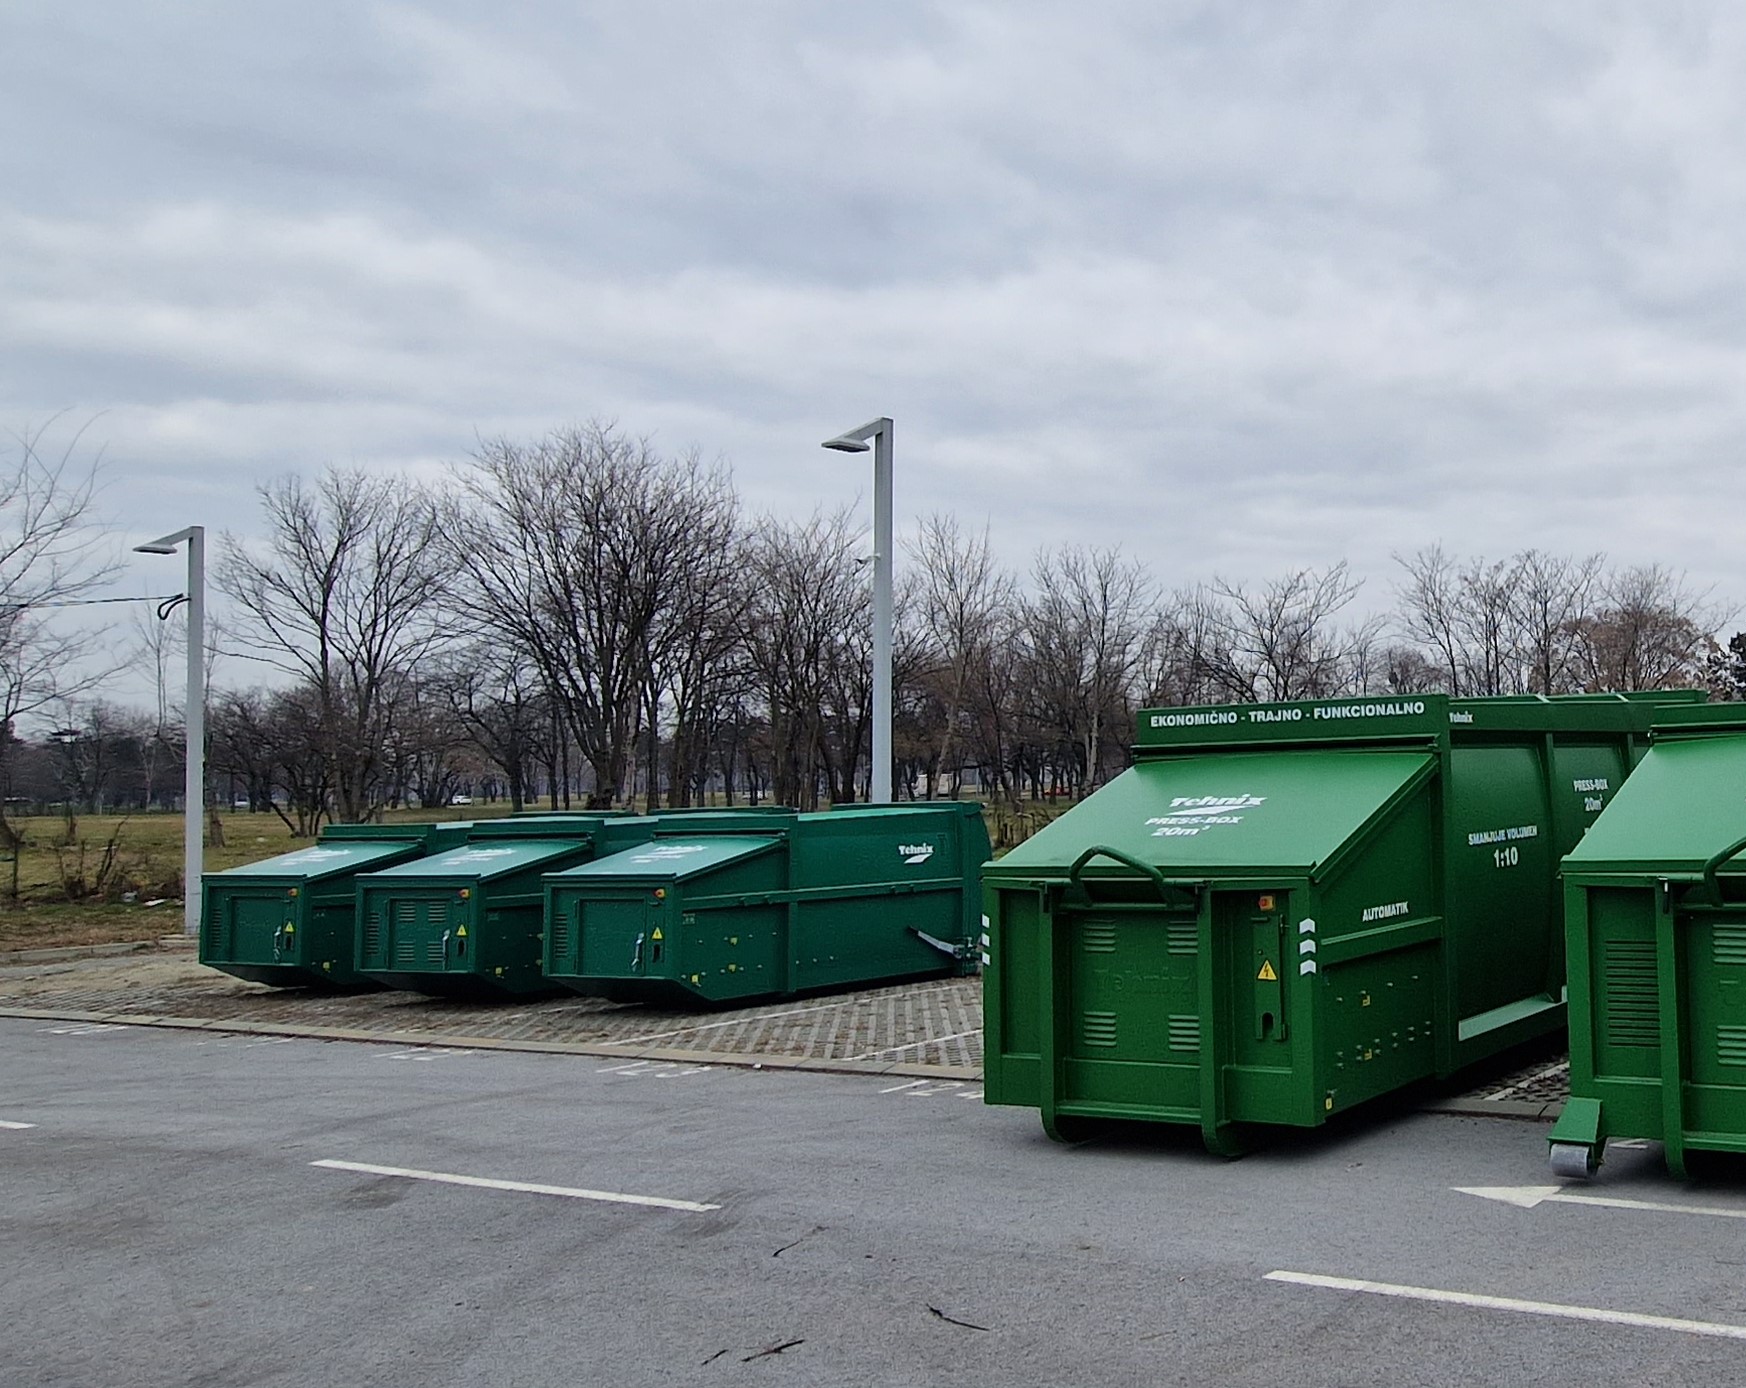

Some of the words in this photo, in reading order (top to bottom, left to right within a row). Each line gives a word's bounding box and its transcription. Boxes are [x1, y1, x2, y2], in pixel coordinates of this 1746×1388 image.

[1150, 710, 1238, 728] EKONOMIČNO
[1248, 708, 1303, 722] TRAJNO
[1313, 702, 1425, 720] FUNKCIONALNO
[1449, 710, 1474, 723] Tehnix
[1573, 778, 1609, 792] PRESS-BOX
[1169, 793, 1268, 808] Tehnix
[1144, 816, 1244, 825] PRESS-BOX
[1468, 829, 1507, 846] SMANJUJE
[1507, 825, 1538, 840] VOLUMEN
[898, 842, 934, 856] Tehnix
[1493, 846, 1519, 868] 1:10
[1363, 901, 1409, 922] AUTOMATIK
